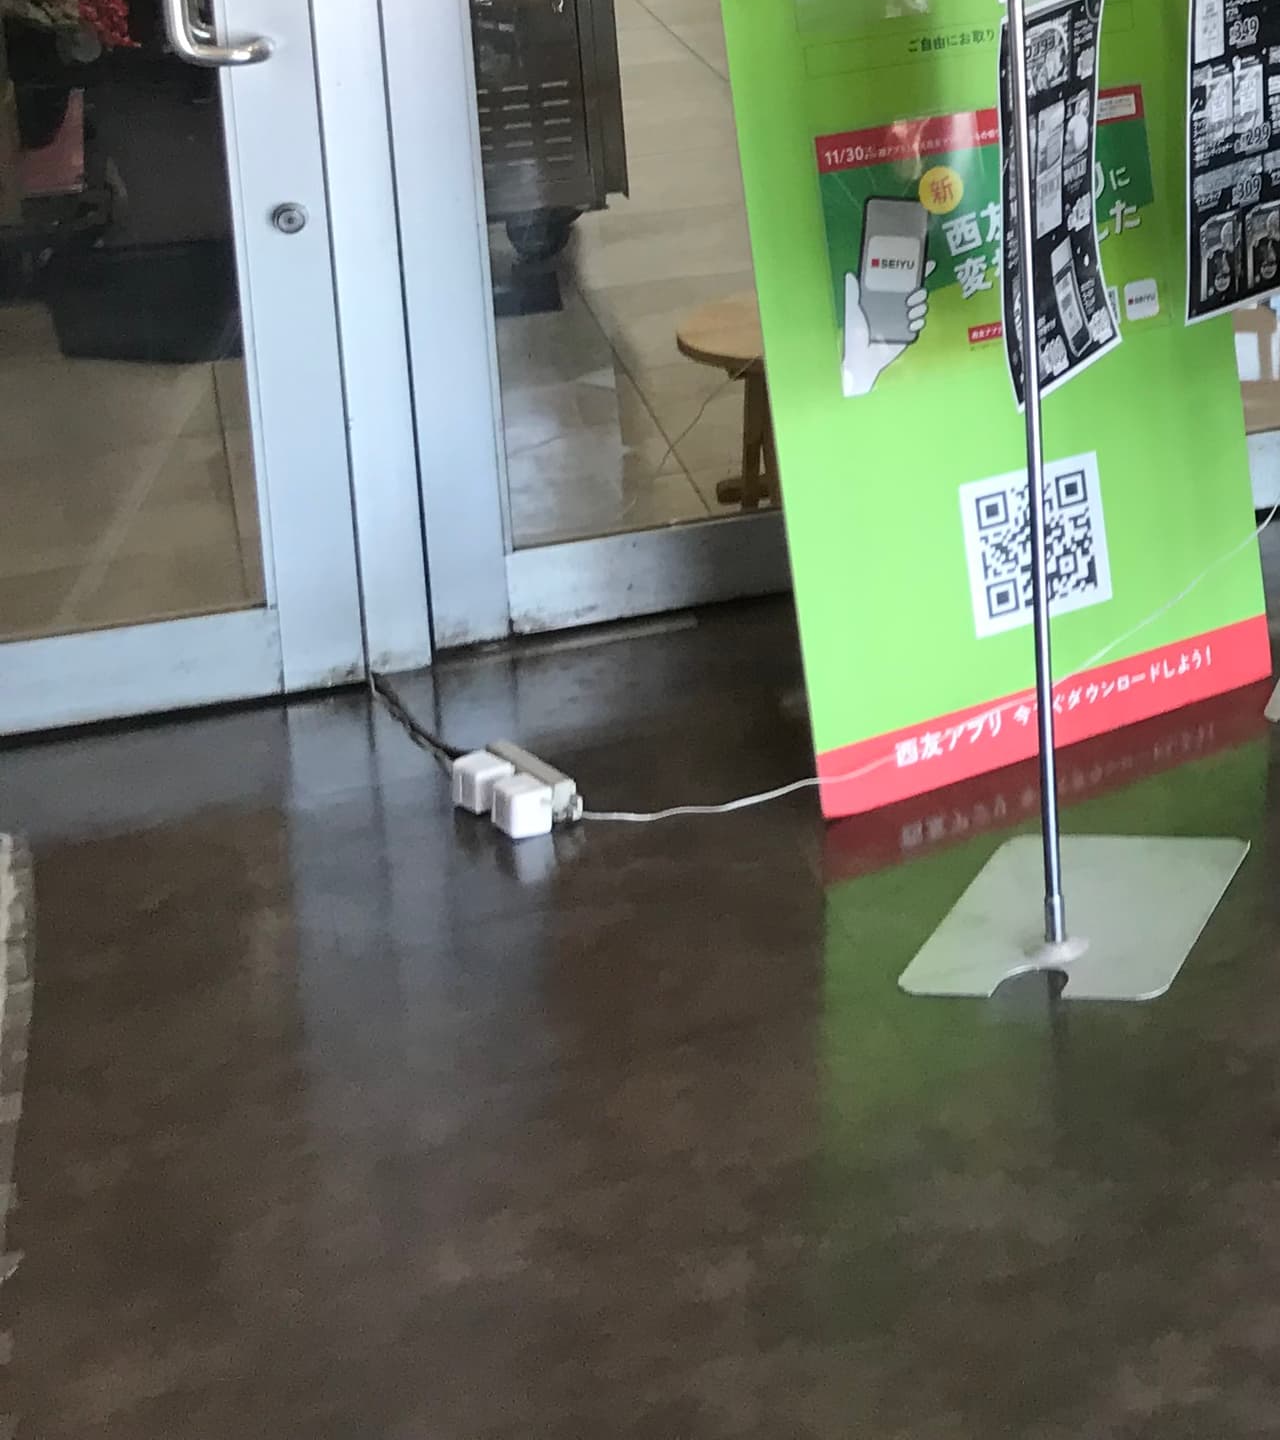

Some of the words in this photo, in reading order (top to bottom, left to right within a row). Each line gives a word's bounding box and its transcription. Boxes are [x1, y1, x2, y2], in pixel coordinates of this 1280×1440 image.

[907, 27, 996, 54] ご自由にお取り
[1245, 121, 1271, 145] 299
[823, 145, 865, 167] 11/30
[930, 176, 955, 205] 新
[1236, 175, 1262, 200] 309
[880, 257, 916, 271] SEIYU
[895, 708, 1002, 768] 西友アプリ
[1013, 645, 1213, 727] 今ぐダウンロードしよう!
